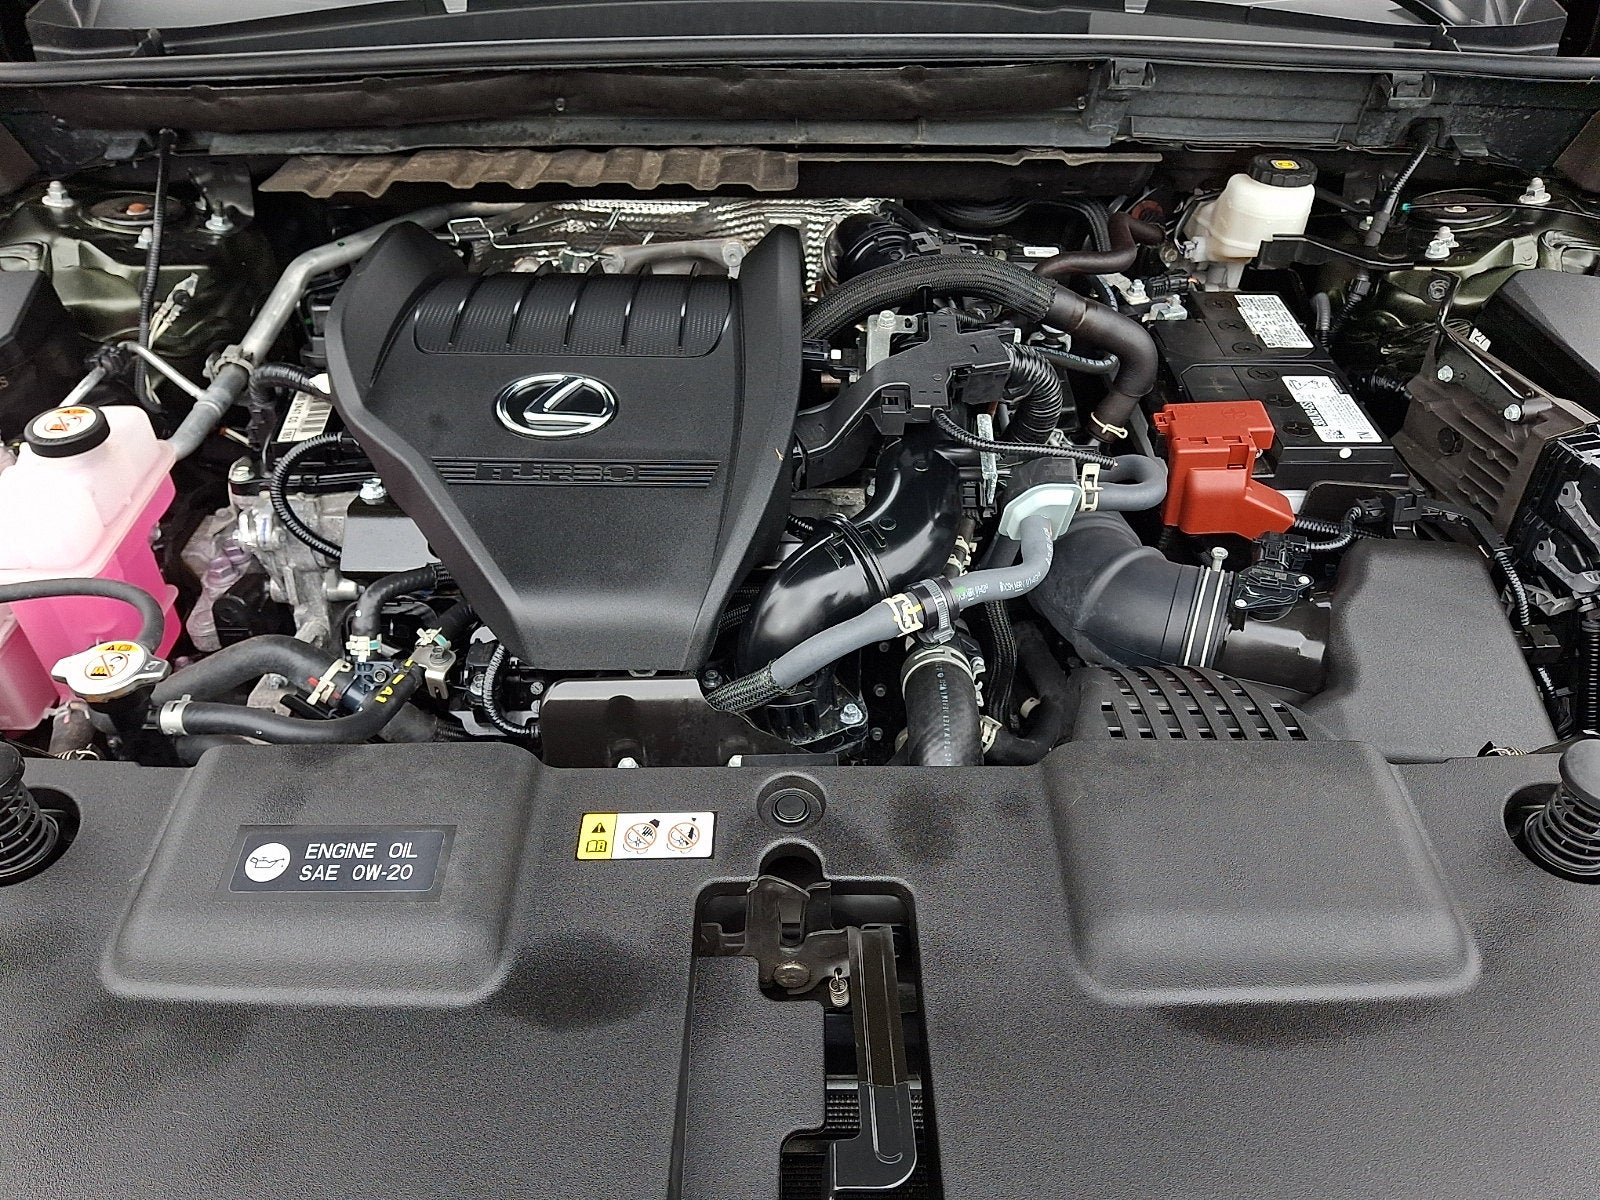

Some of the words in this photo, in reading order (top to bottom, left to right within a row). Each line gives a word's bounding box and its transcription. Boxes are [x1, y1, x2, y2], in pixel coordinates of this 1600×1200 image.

[477, 463, 636, 482] TURBO
[304, 842, 378, 860] ENGINE
[388, 841, 418, 859] OIL
[299, 863, 341, 882] SAE
[352, 863, 415, 882] 0W-20
